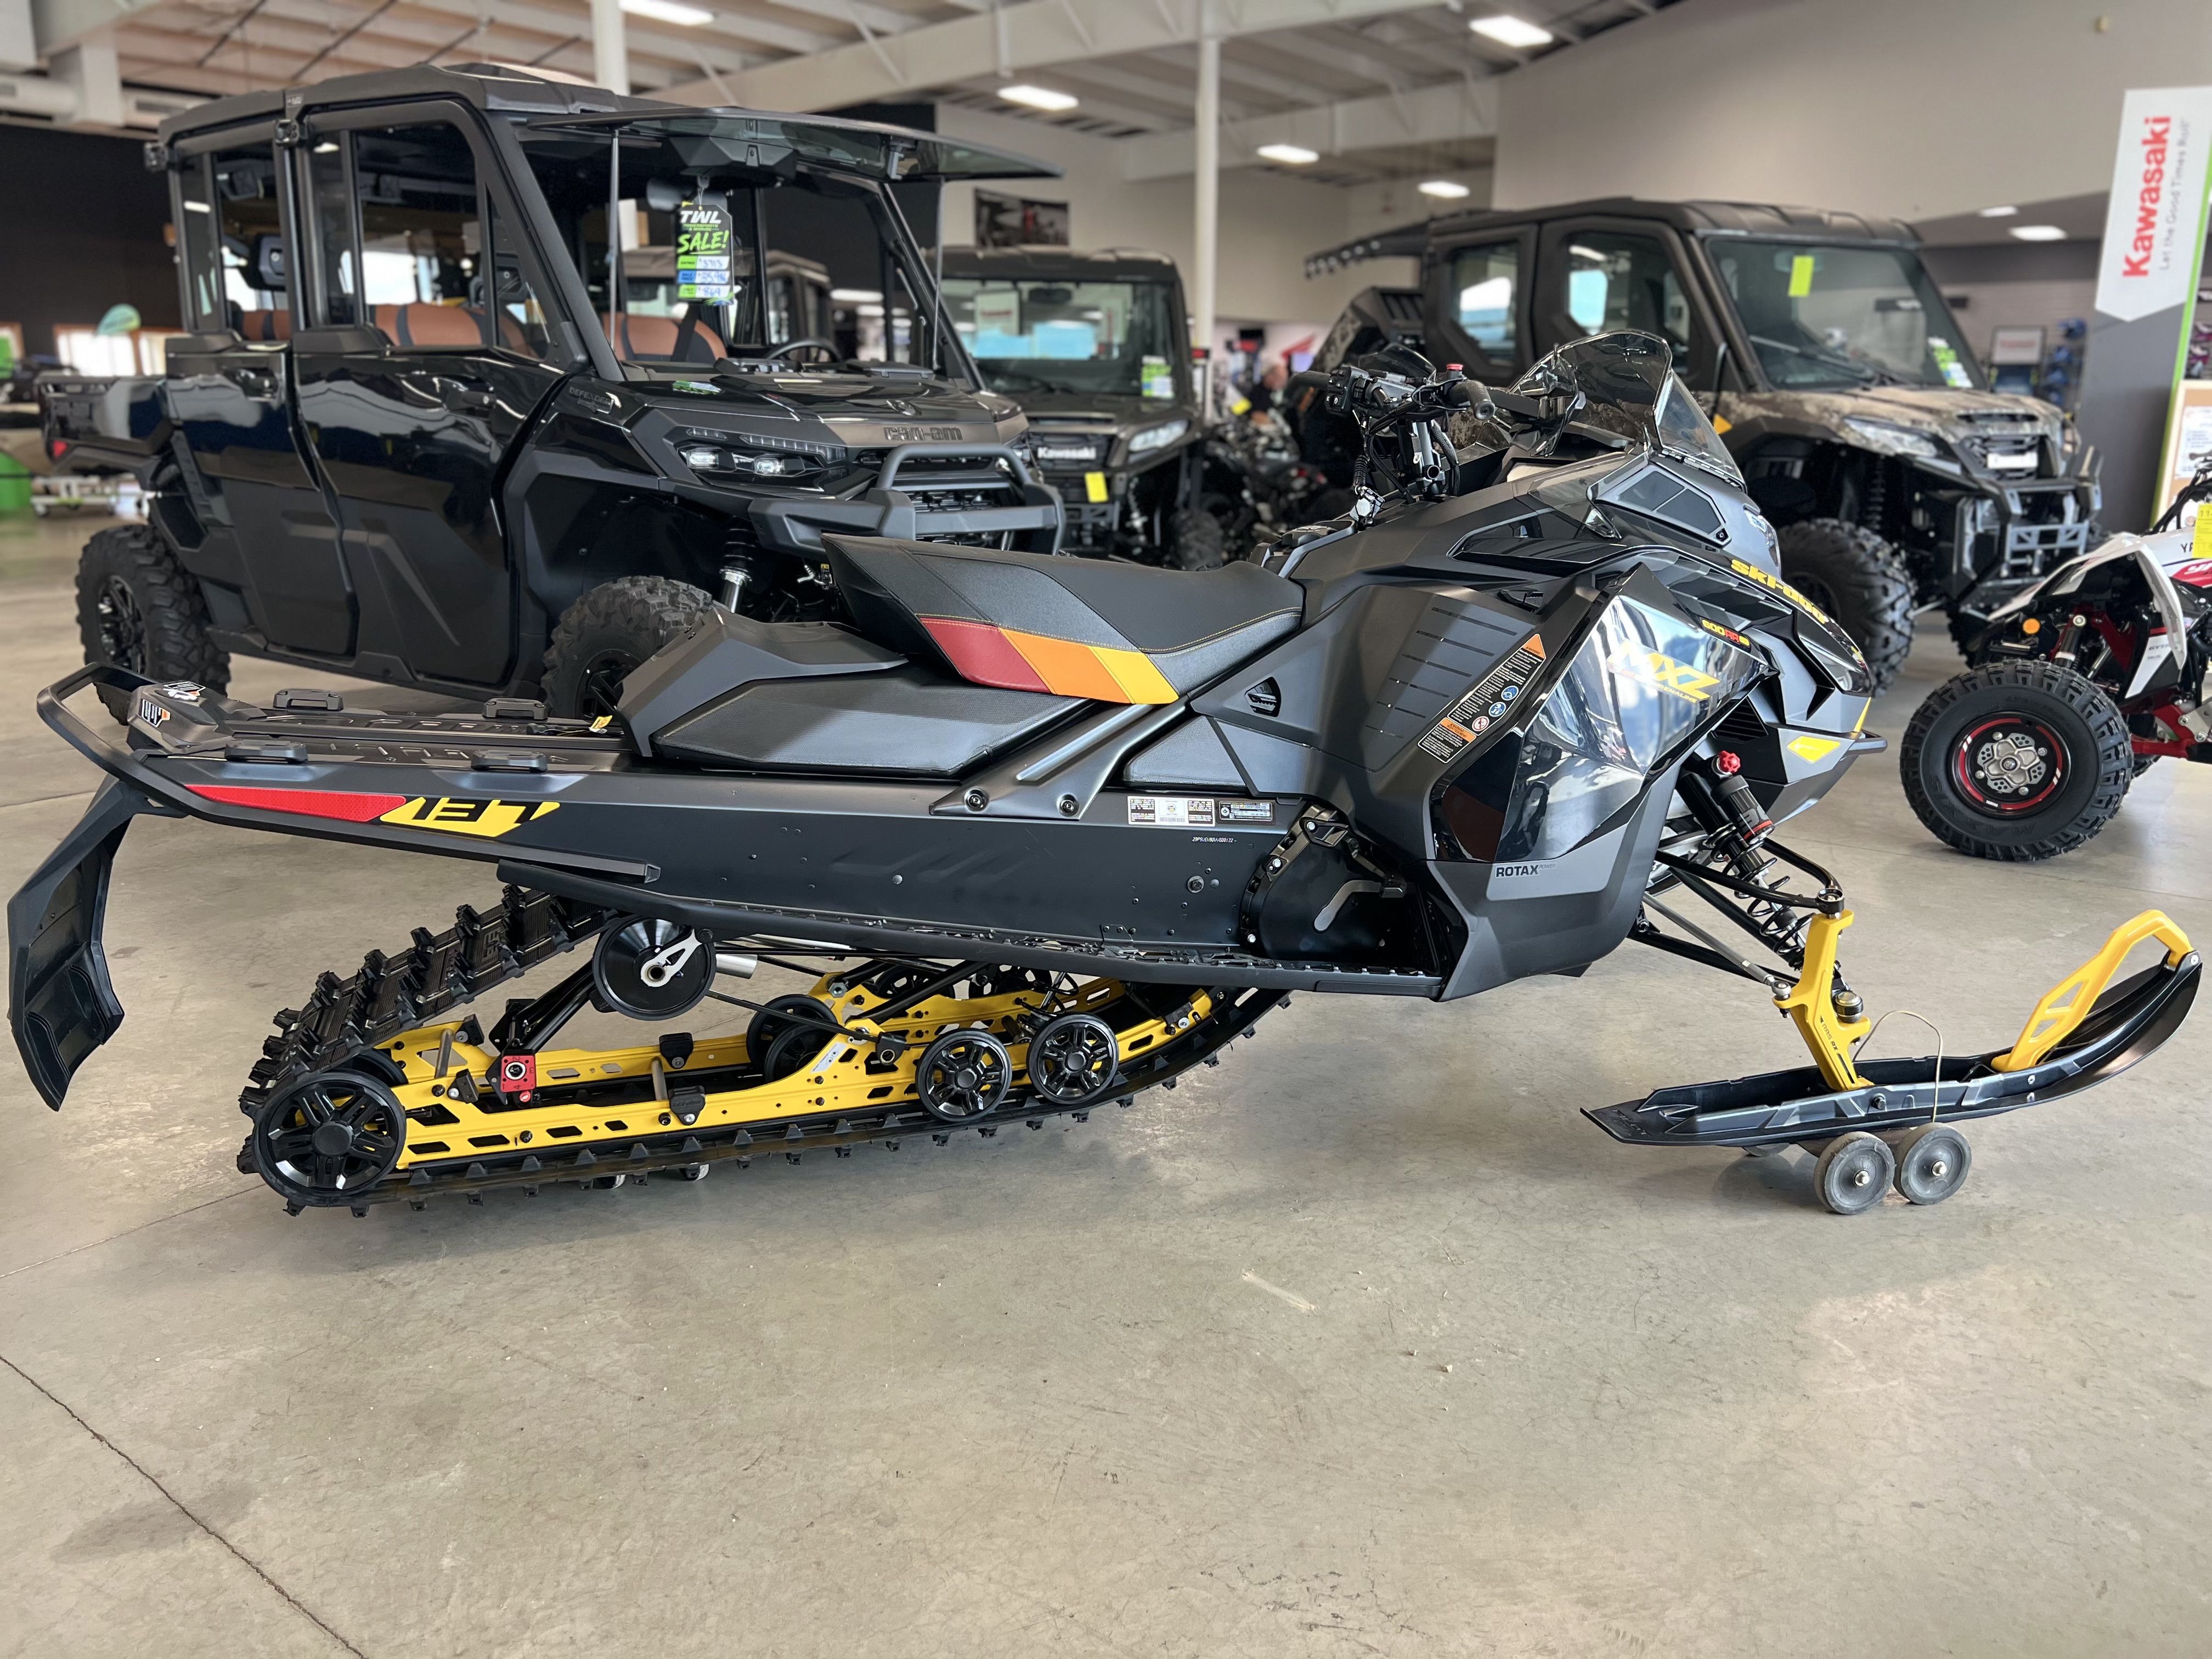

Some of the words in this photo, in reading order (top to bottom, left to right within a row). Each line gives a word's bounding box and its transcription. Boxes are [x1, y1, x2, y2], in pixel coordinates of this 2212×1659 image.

[2122, 116, 2171, 276] Kawasaki
[680, 210, 721, 224] TWL
[2159, 250, 2171, 270] Let
[2171, 150, 2187, 187] Times
[676, 230, 730, 254] SALE!
[569, 386, 611, 405] DEFENDER
[1608, 640, 1721, 700] MXZ
[1496, 865, 1539, 877] ROTAX
[1822, 1023, 1833, 1040] RAS
